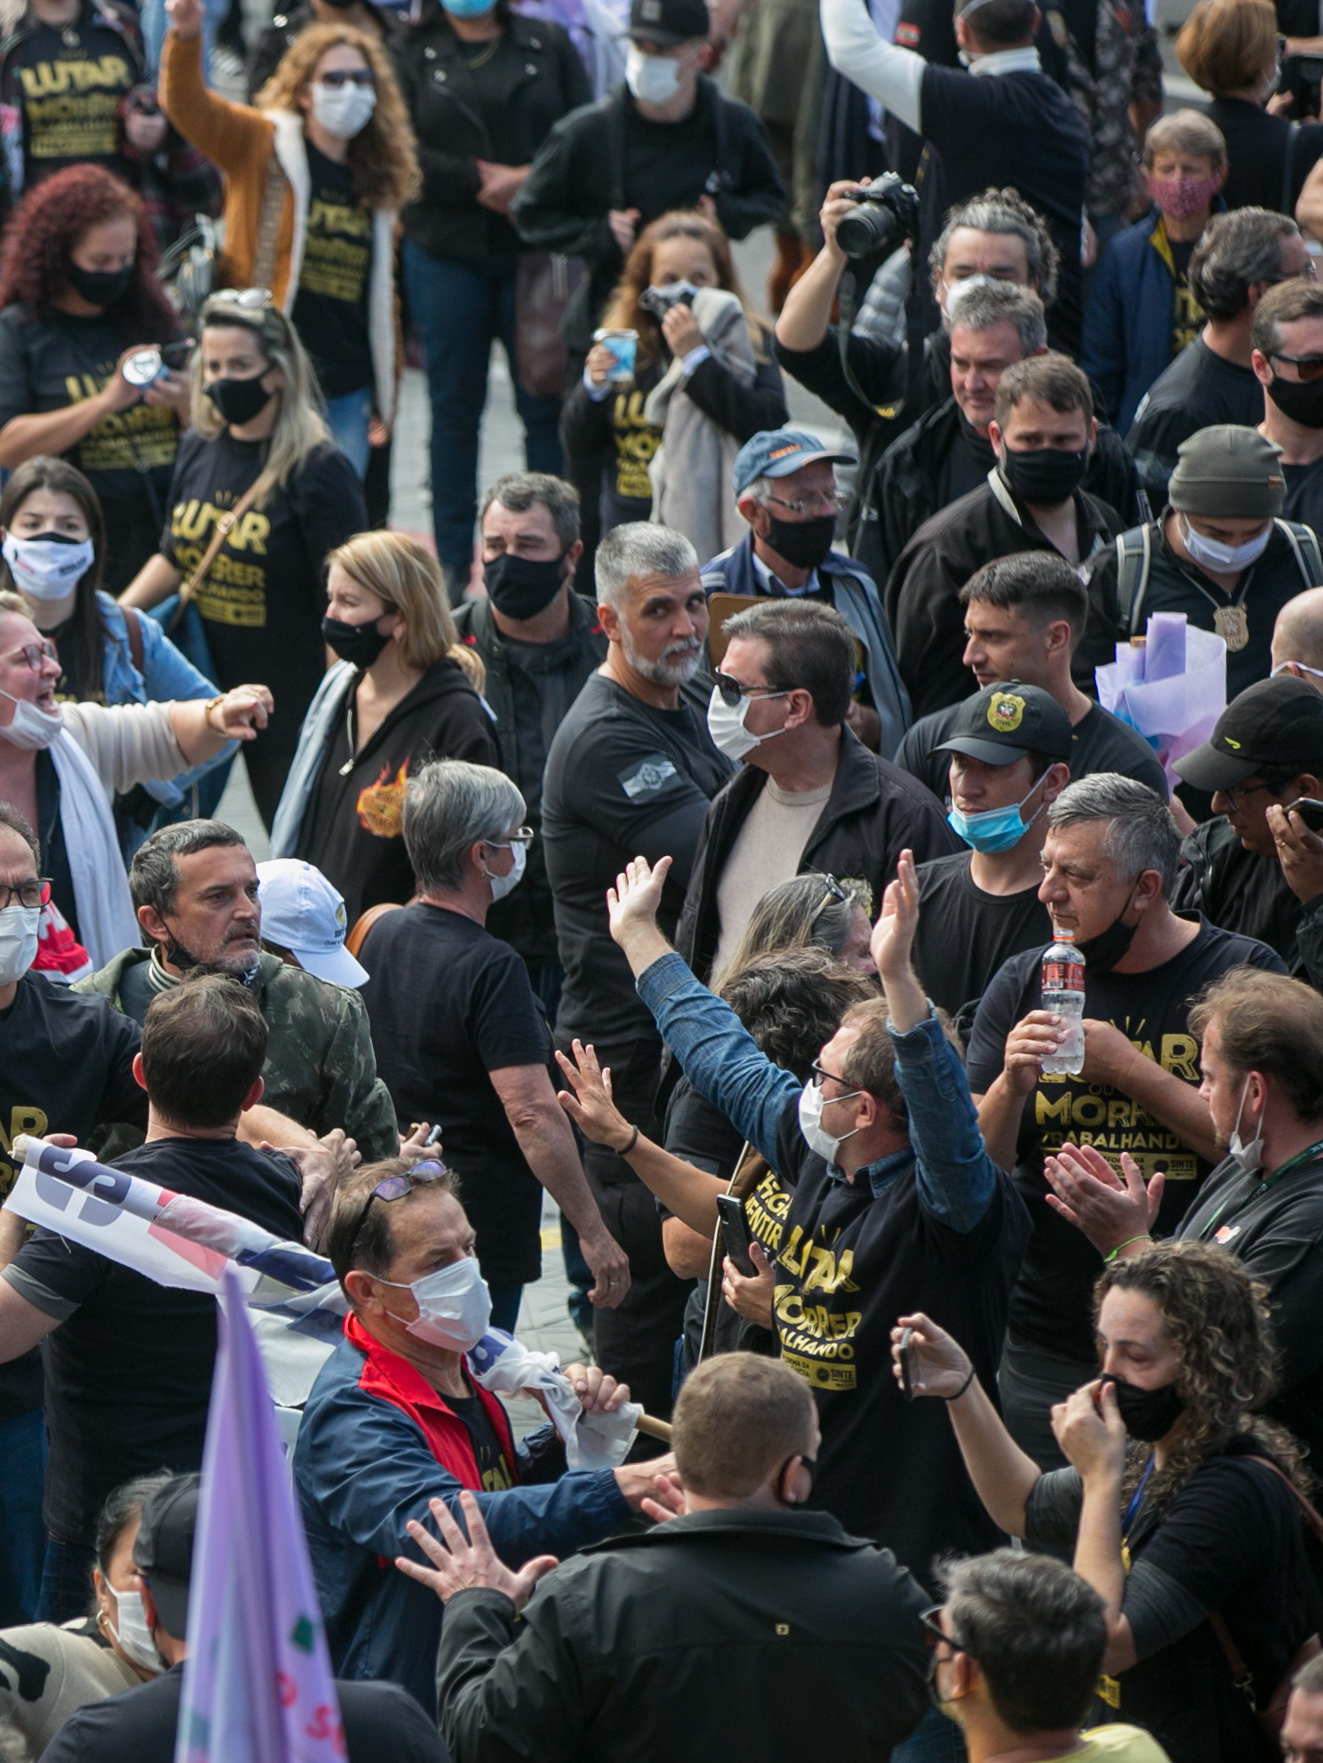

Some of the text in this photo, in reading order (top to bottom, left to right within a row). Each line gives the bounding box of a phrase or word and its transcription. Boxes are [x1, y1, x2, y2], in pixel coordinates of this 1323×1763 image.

[21, 55, 132, 98] LUTAR
[1035, 1090, 1152, 1129] MORR
[778, 1327, 855, 1361] ALHANDO
[830, 1368, 854, 1380] SINTE
